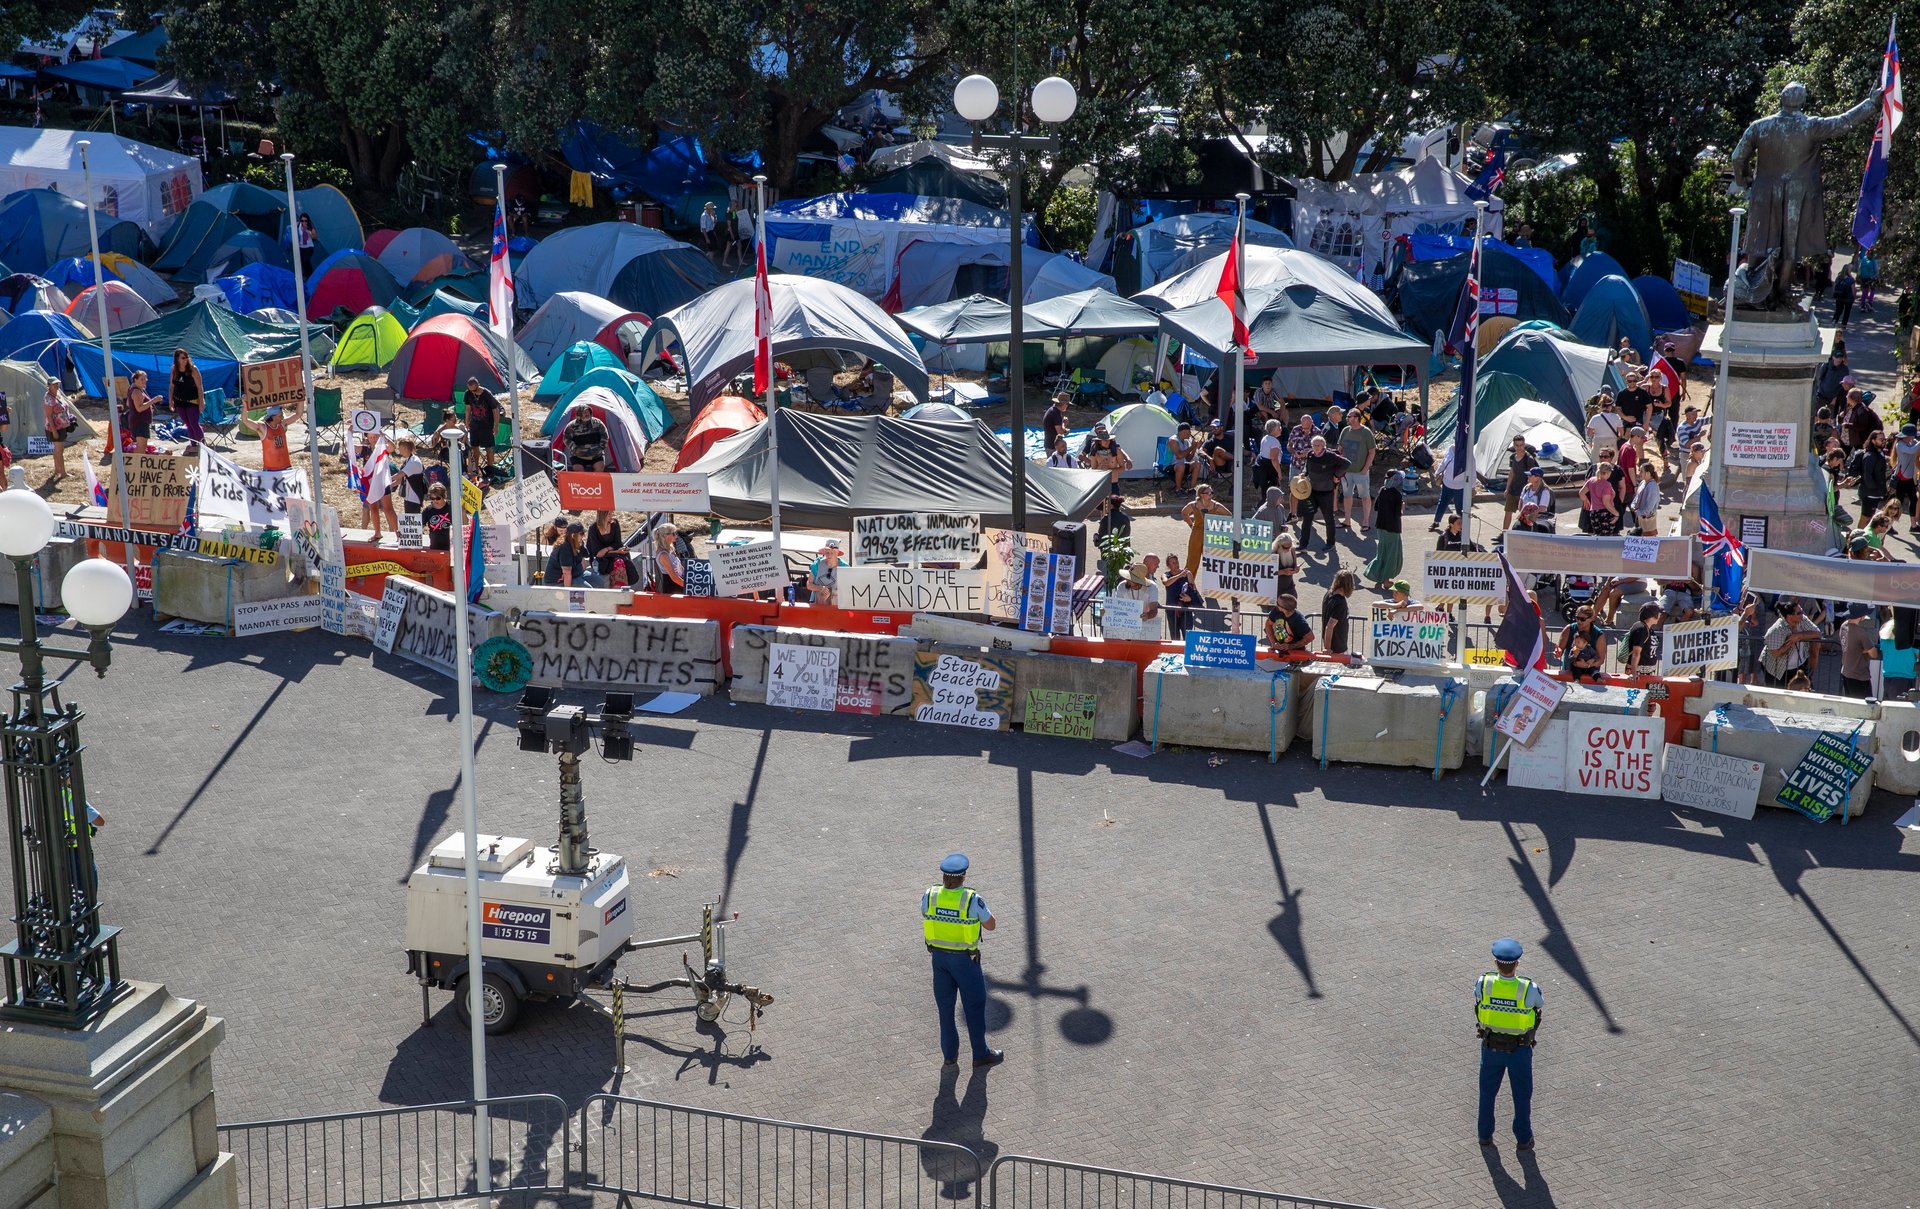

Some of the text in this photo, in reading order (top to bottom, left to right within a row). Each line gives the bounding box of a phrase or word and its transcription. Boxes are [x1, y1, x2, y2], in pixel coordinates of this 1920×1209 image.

[250, 389, 304, 407] MANDATES
[140, 456, 176, 471] POLICE
[140, 471, 177, 484] HAVE A
[151, 485, 161, 497] TO
[212, 478, 243, 501] kids
[468, 490, 477, 501] ALL
[162, 498, 185, 521] IT
[488, 495, 503, 509] THE
[513, 493, 561, 528] THEIR OATH
[504, 500, 533, 522] ALL IN
[857, 513, 979, 534] NATURAL IMMUNITY
[1206, 519, 1271, 538] WHT IF
[58, 521, 276, 564] END MANDATES END MANDATES
[399, 539, 423, 547] ALONE!
[902, 533, 980, 553] EFFECTIVE!!
[1206, 534, 1230, 546] THE
[719, 551, 735, 559] THEY
[748, 545, 773, 554] WILLING
[747, 552, 772, 561] SOCIETY
[321, 562, 343, 577] WHAT'S
[687, 559, 712, 572] Rea
[721, 566, 779, 579] ALMOST EVERYONE.
[729, 563, 748, 571] APART
[1204, 556, 1275, 579] LET PEOPLE
[1427, 565, 1503, 578] END APARTHEID
[323, 574, 339, 587] NEXT
[686, 571, 713, 584] Real
[879, 569, 956, 585] END THE
[1218, 575, 1259, 593] WORK
[1433, 579, 1496, 591] WE GO HOME
[321, 584, 344, 600] TREVOR?
[384, 589, 405, 605] POLICE
[685, 583, 711, 596] Real
[851, 584, 982, 611] MANDATE
[238, 599, 320, 615] STOP VAX PASS AND
[322, 608, 343, 623] CALL US
[239, 616, 322, 631] MANDATE COERSION
[1372, 608, 1448, 625] HE JACINDA
[379, 618, 397, 633] NEVER
[1373, 623, 1446, 640] LEAVE OUR
[521, 619, 690, 653] STOP THE
[1199, 635, 1243, 647] NZ POLICE,
[1672, 628, 1729, 650] WHERE'S
[840, 636, 890, 669] THE
[1195, 644, 1208, 653] We
[1223, 646, 1246, 657] doing
[1374, 639, 1446, 659] KIDS ALONE
[1671, 644, 1729, 666] CLARKE?
[777, 649, 837, 667] WE VOTED
[1190, 653, 1250, 665] this for you too.
[1472, 655, 1496, 665] STOP
[541, 655, 695, 685] MANDATES
[773, 662, 838, 687] 4 YOU WE
[940, 657, 979, 677] Stay
[929, 670, 998, 689] peaceful
[1535, 675, 1559, 691] EVERYTHING
[837, 684, 871, 696] REE TO
[935, 688, 975, 709] Stop
[1036, 690, 1084, 702] LET ME
[1522, 684, 1555, 708] AWESOME!
[836, 696, 872, 708] HOOSE
[1036, 701, 1082, 713] DANCE
[917, 706, 995, 728] Mandates
[1032, 711, 1038, 721] I
[1036, 721, 1092, 738] FREEDOM!
[1587, 727, 1650, 750] GOVT
[1584, 750, 1653, 771] IS THE
[1667, 746, 1751, 775] END MANDATES.
[1807, 750, 1859, 783] WITHOUT
[1814, 742, 1866, 774] VULNERABLE
[1853, 751, 1871, 766] THE
[1666, 760, 1758, 792] THAT ARE ATTACKING
[1799, 761, 1835, 782] PUTTING
[1578, 769, 1651, 792] VIRUS
[1662, 774, 1726, 798] OUR FREEDOMS
[1788, 769, 1844, 807] LIVES
[1662, 786, 1704, 806] BUSINESSES
[1780, 786, 1801, 801] AT
[1800, 794, 1833, 819] RISK
[488, 907, 546, 924] Hirepool
[606, 900, 625, 922] Hirepool
[937, 908, 958, 916] POLICE
[501, 927, 538, 941] 15 15 15
[1491, 998, 1516, 1006] POLICE
